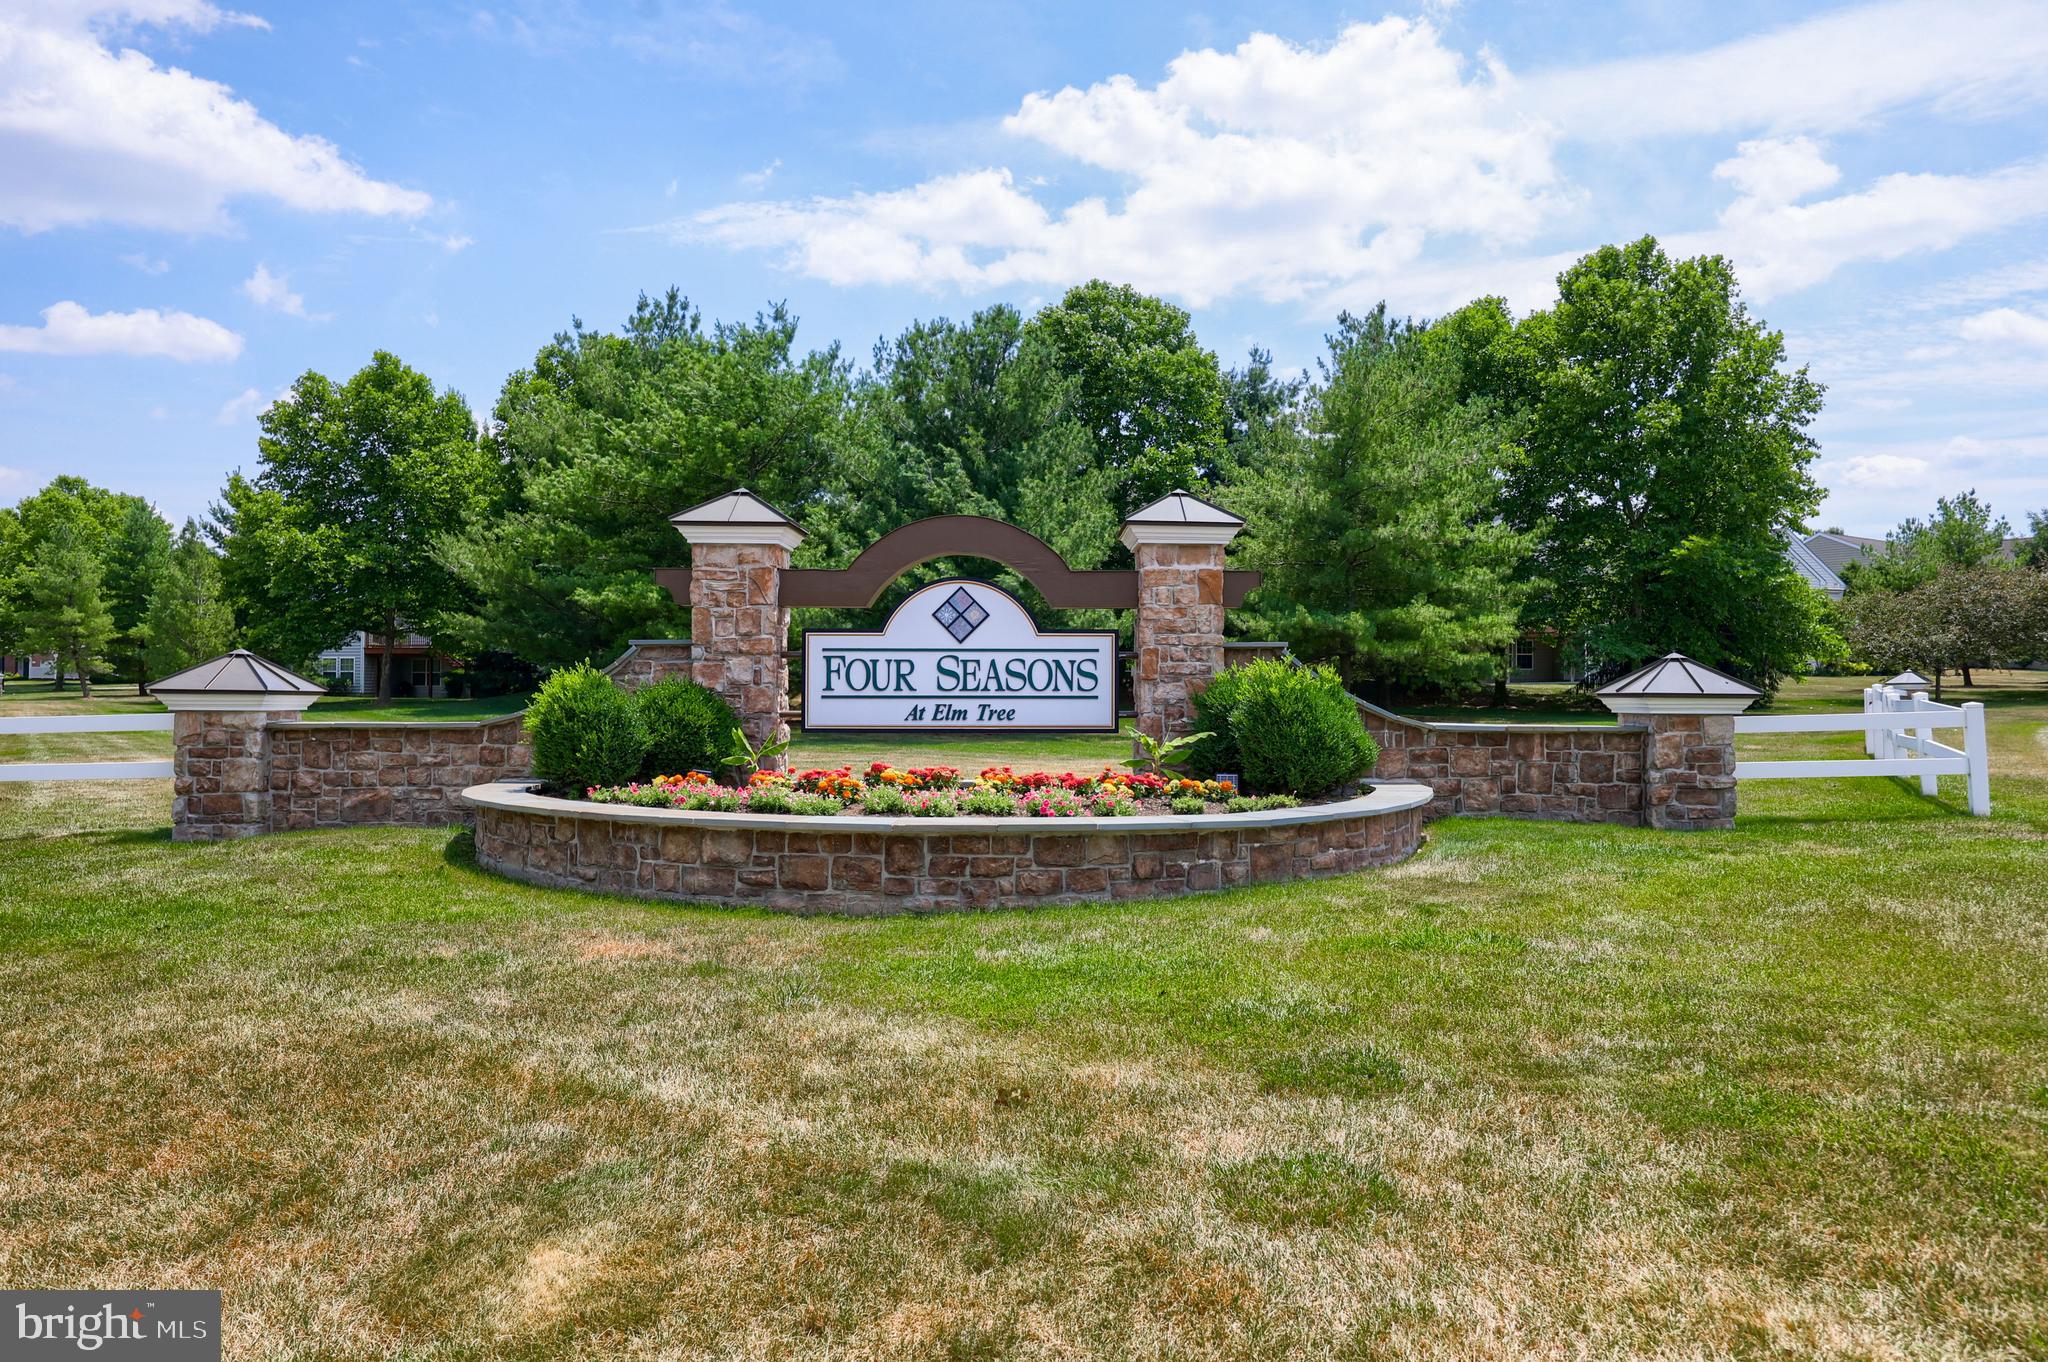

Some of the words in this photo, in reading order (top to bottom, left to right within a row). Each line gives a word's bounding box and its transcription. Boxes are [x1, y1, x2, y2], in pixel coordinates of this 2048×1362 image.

[822, 655, 917, 692] FOUR
[936, 654, 1099, 692] SEASONS
[904, 704, 926, 722] At
[931, 704, 968, 722] Elm
[977, 704, 1016, 722] Tree
